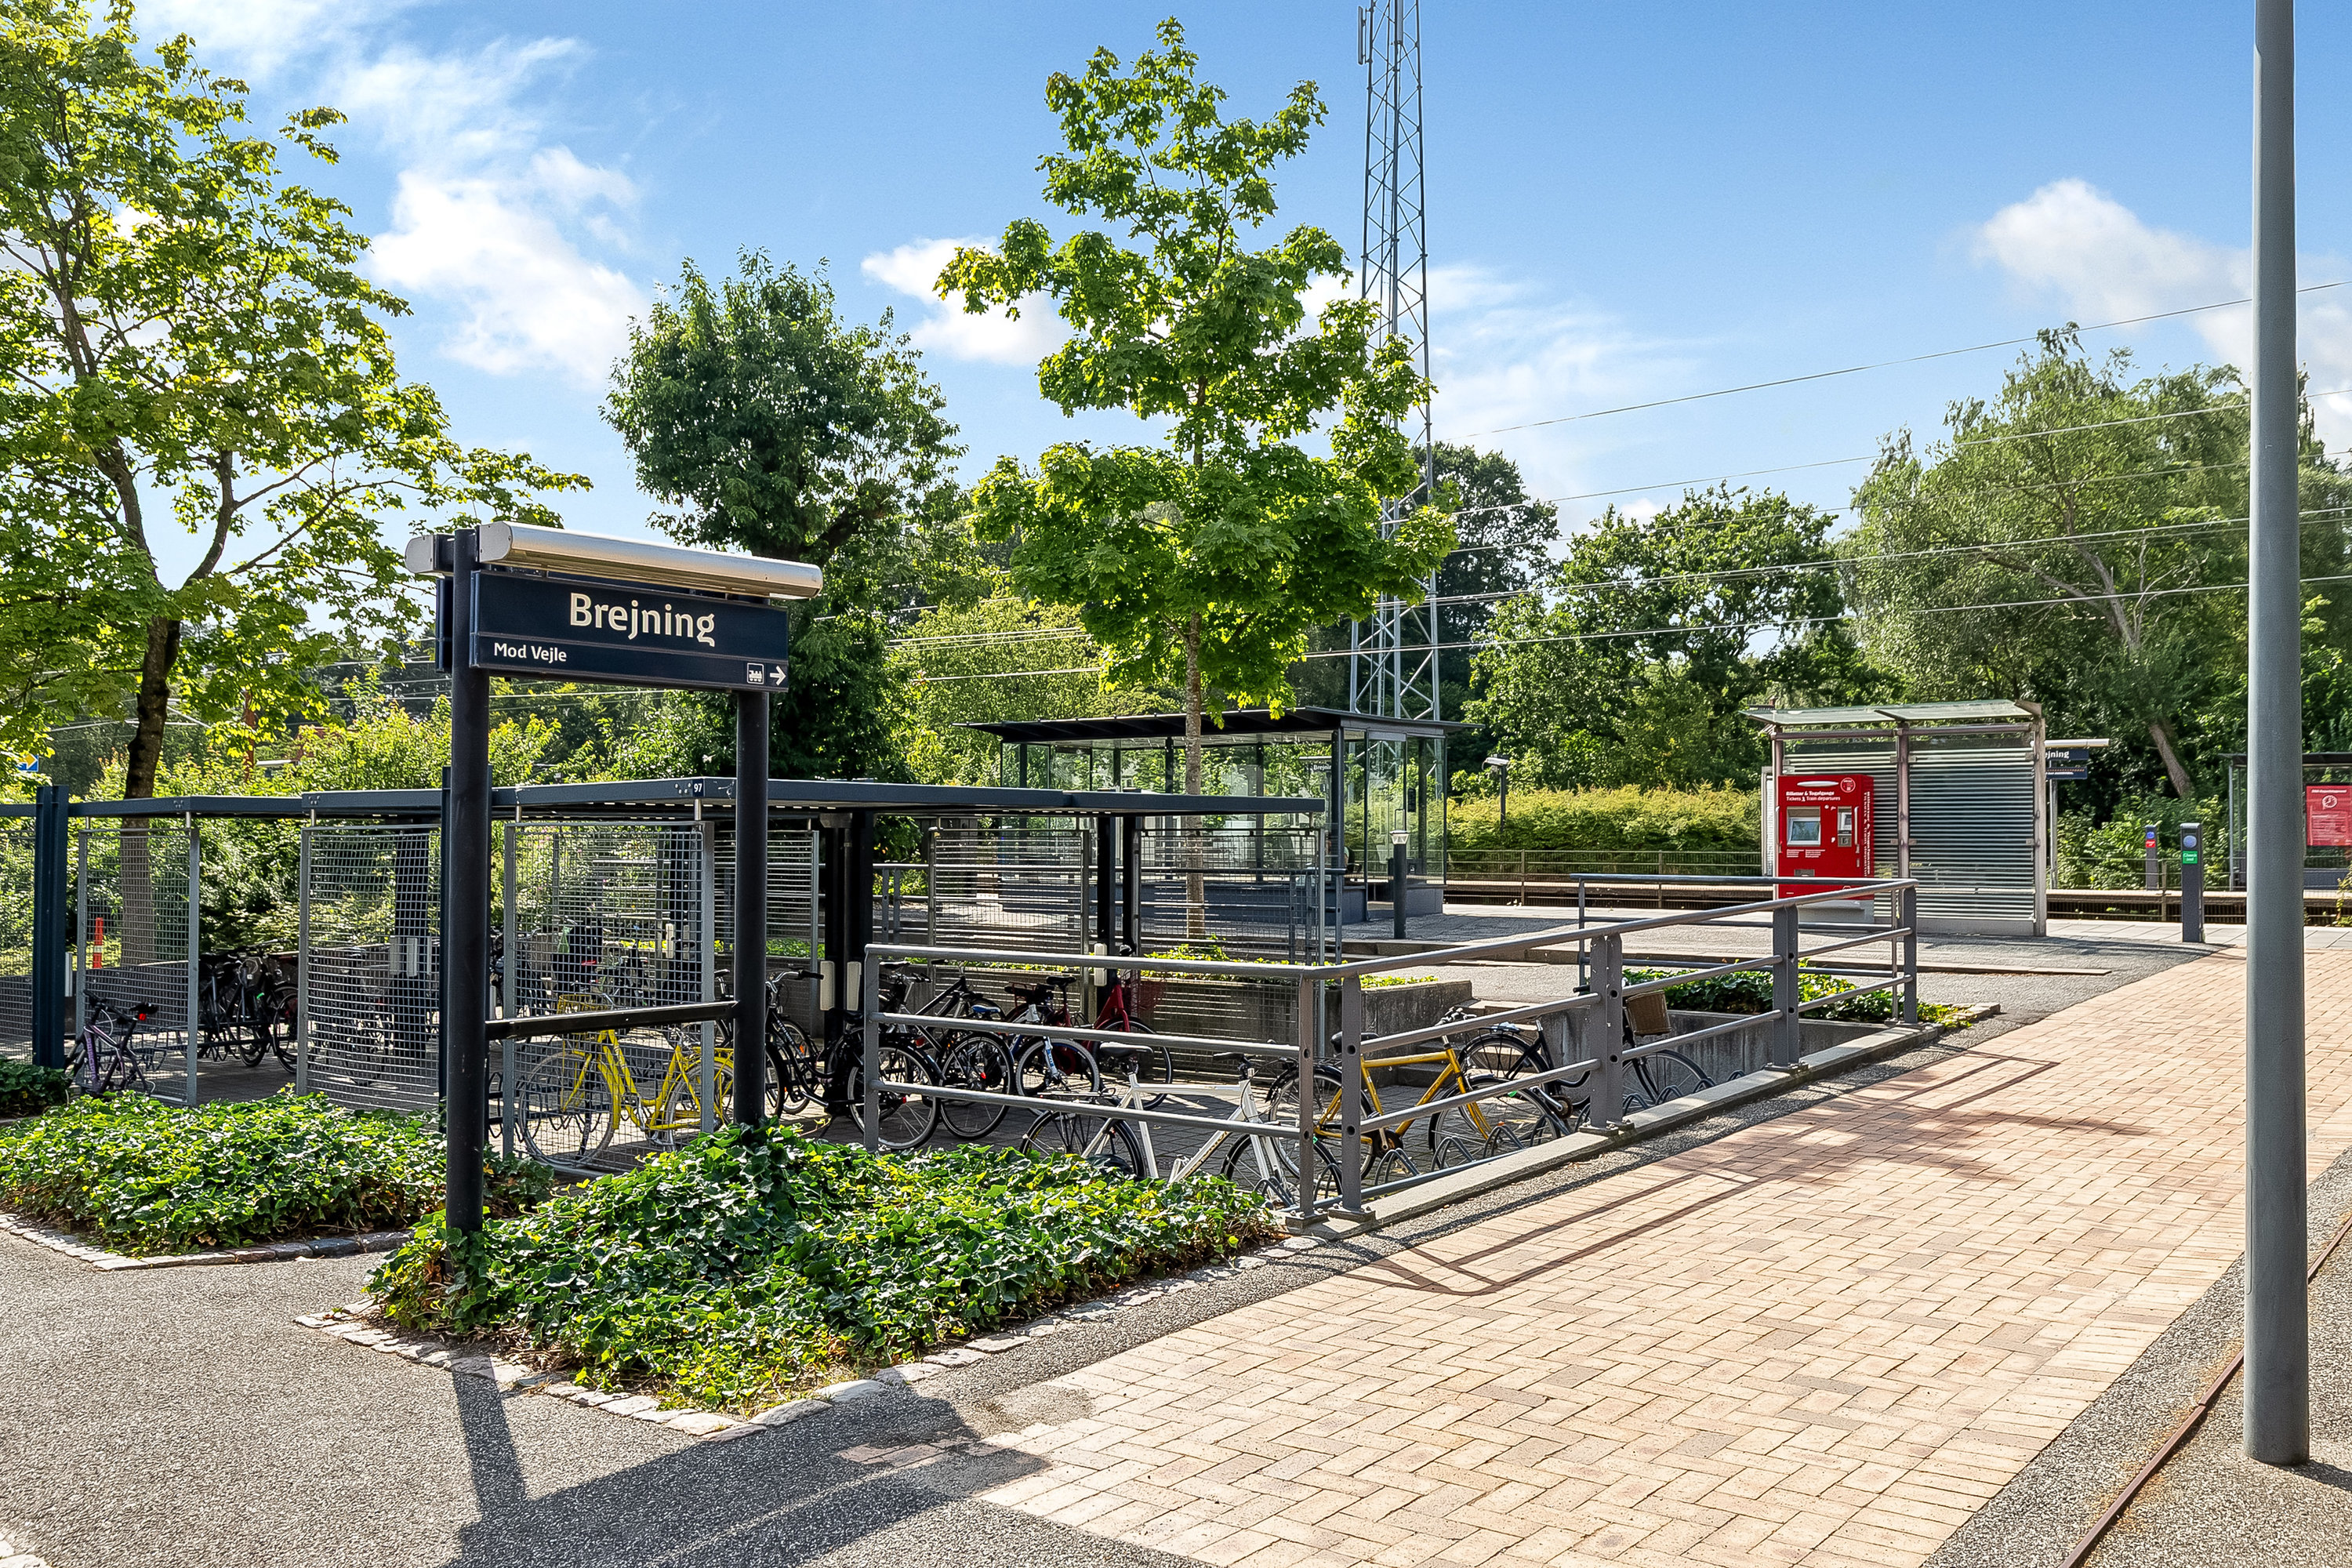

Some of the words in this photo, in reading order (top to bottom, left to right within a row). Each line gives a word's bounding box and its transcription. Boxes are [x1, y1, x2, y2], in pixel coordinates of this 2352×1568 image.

[571, 592, 715, 648] Brejning
[494, 642, 527, 659] Mod
[530, 645, 567, 664] Vejle
[2045, 750, 2070, 759] ejning
[693, 782, 702, 793] 97
